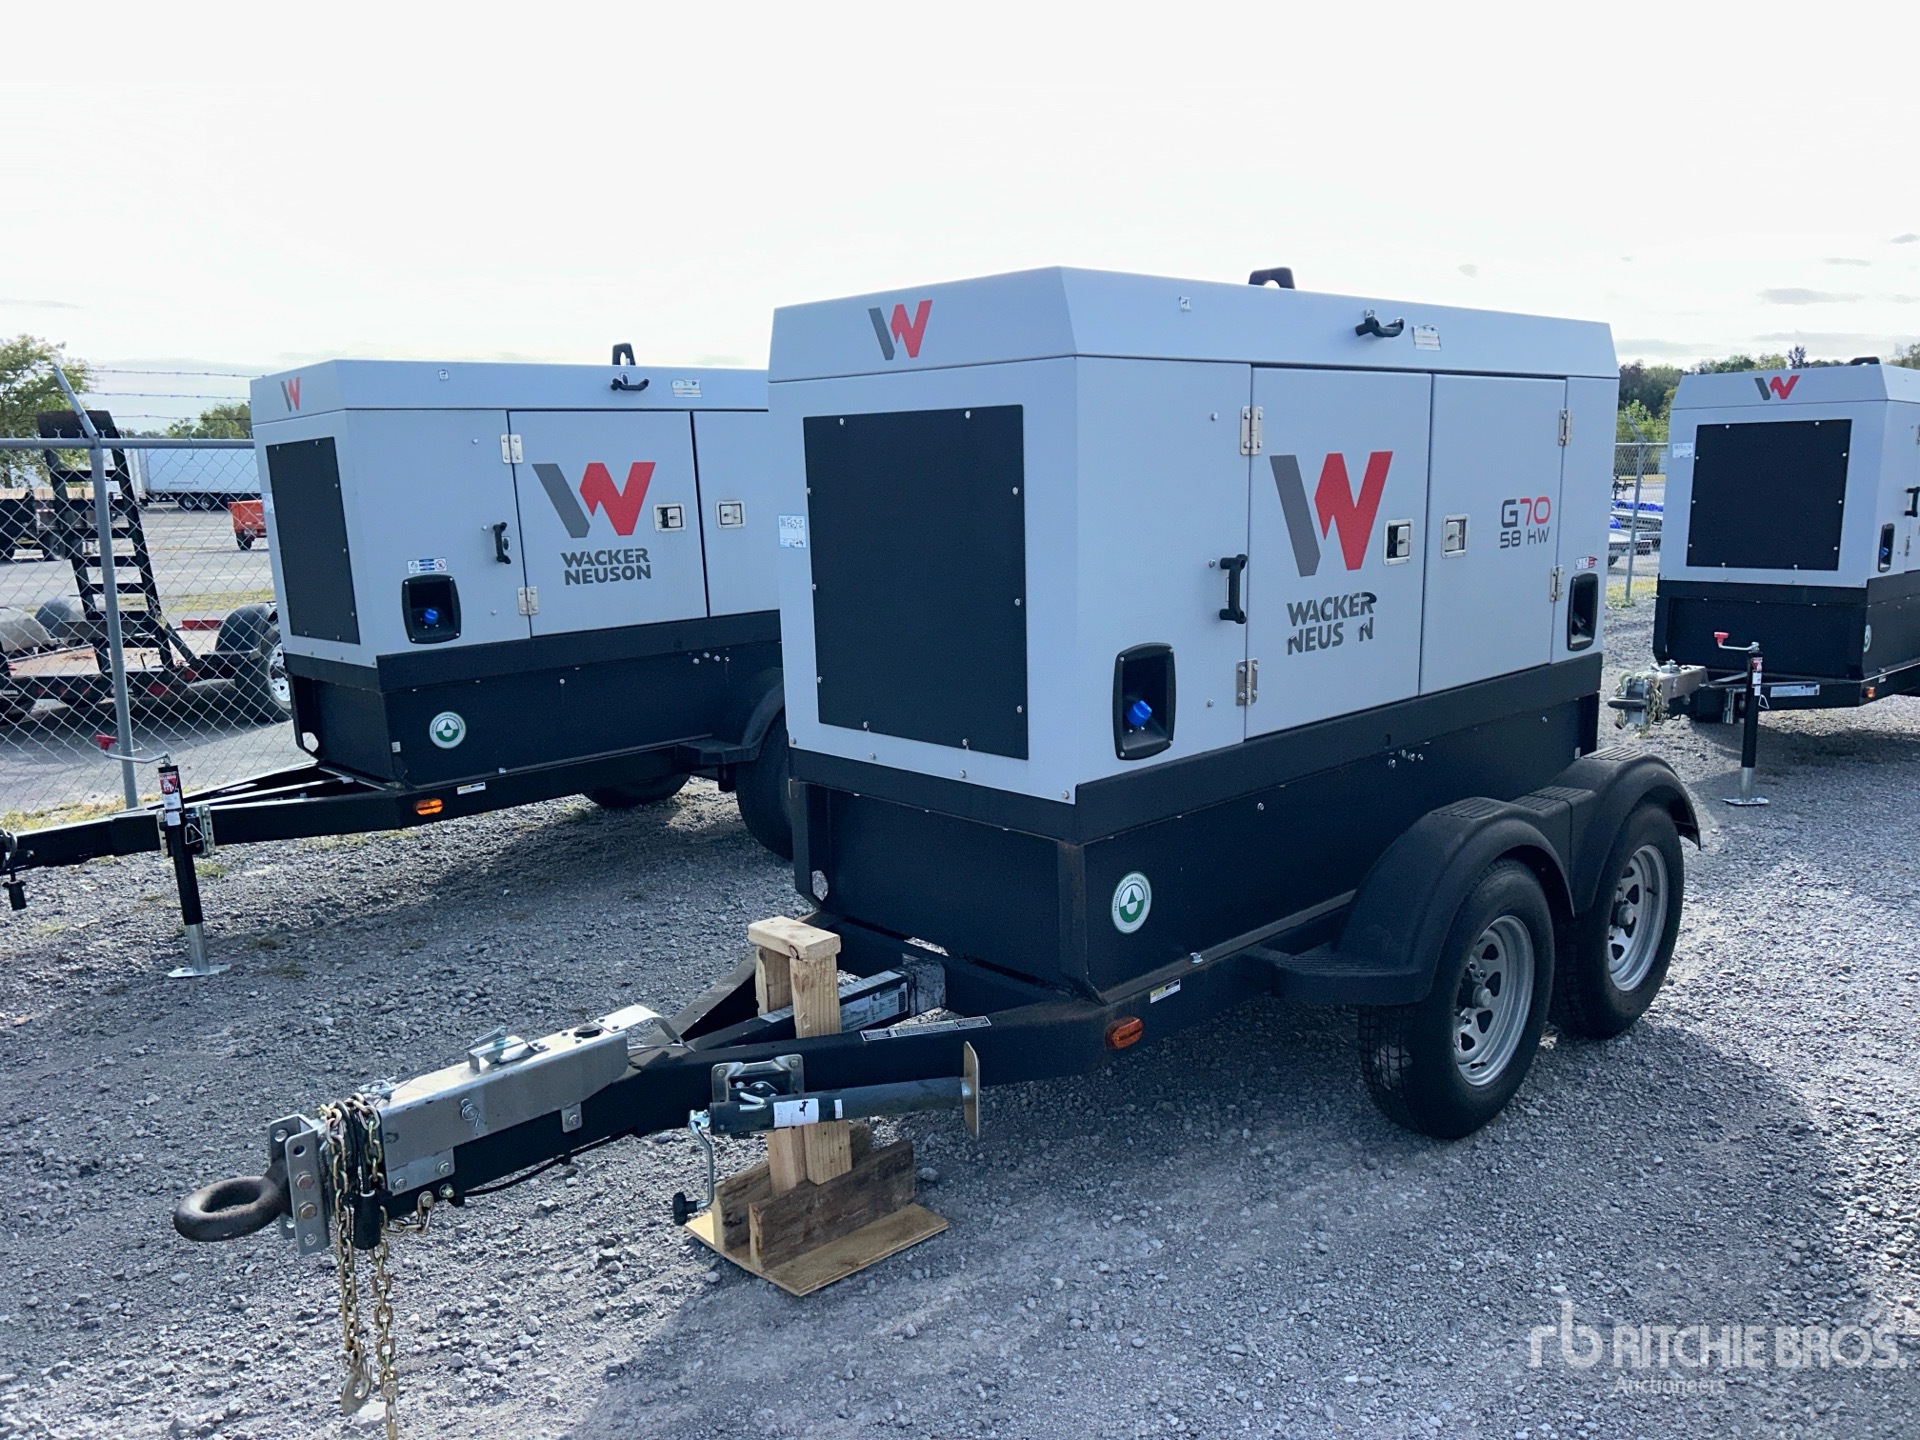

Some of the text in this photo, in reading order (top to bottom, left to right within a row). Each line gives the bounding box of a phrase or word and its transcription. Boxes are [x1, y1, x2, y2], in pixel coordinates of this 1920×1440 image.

[1501, 496, 1550, 528] G70
[1500, 530, 1521, 549] 58
[560, 548, 650, 568] WACKER
[564, 564, 651, 586] NEUSON
[1286, 591, 1377, 627] WACKER
[1287, 616, 1374, 655] NEUSN
